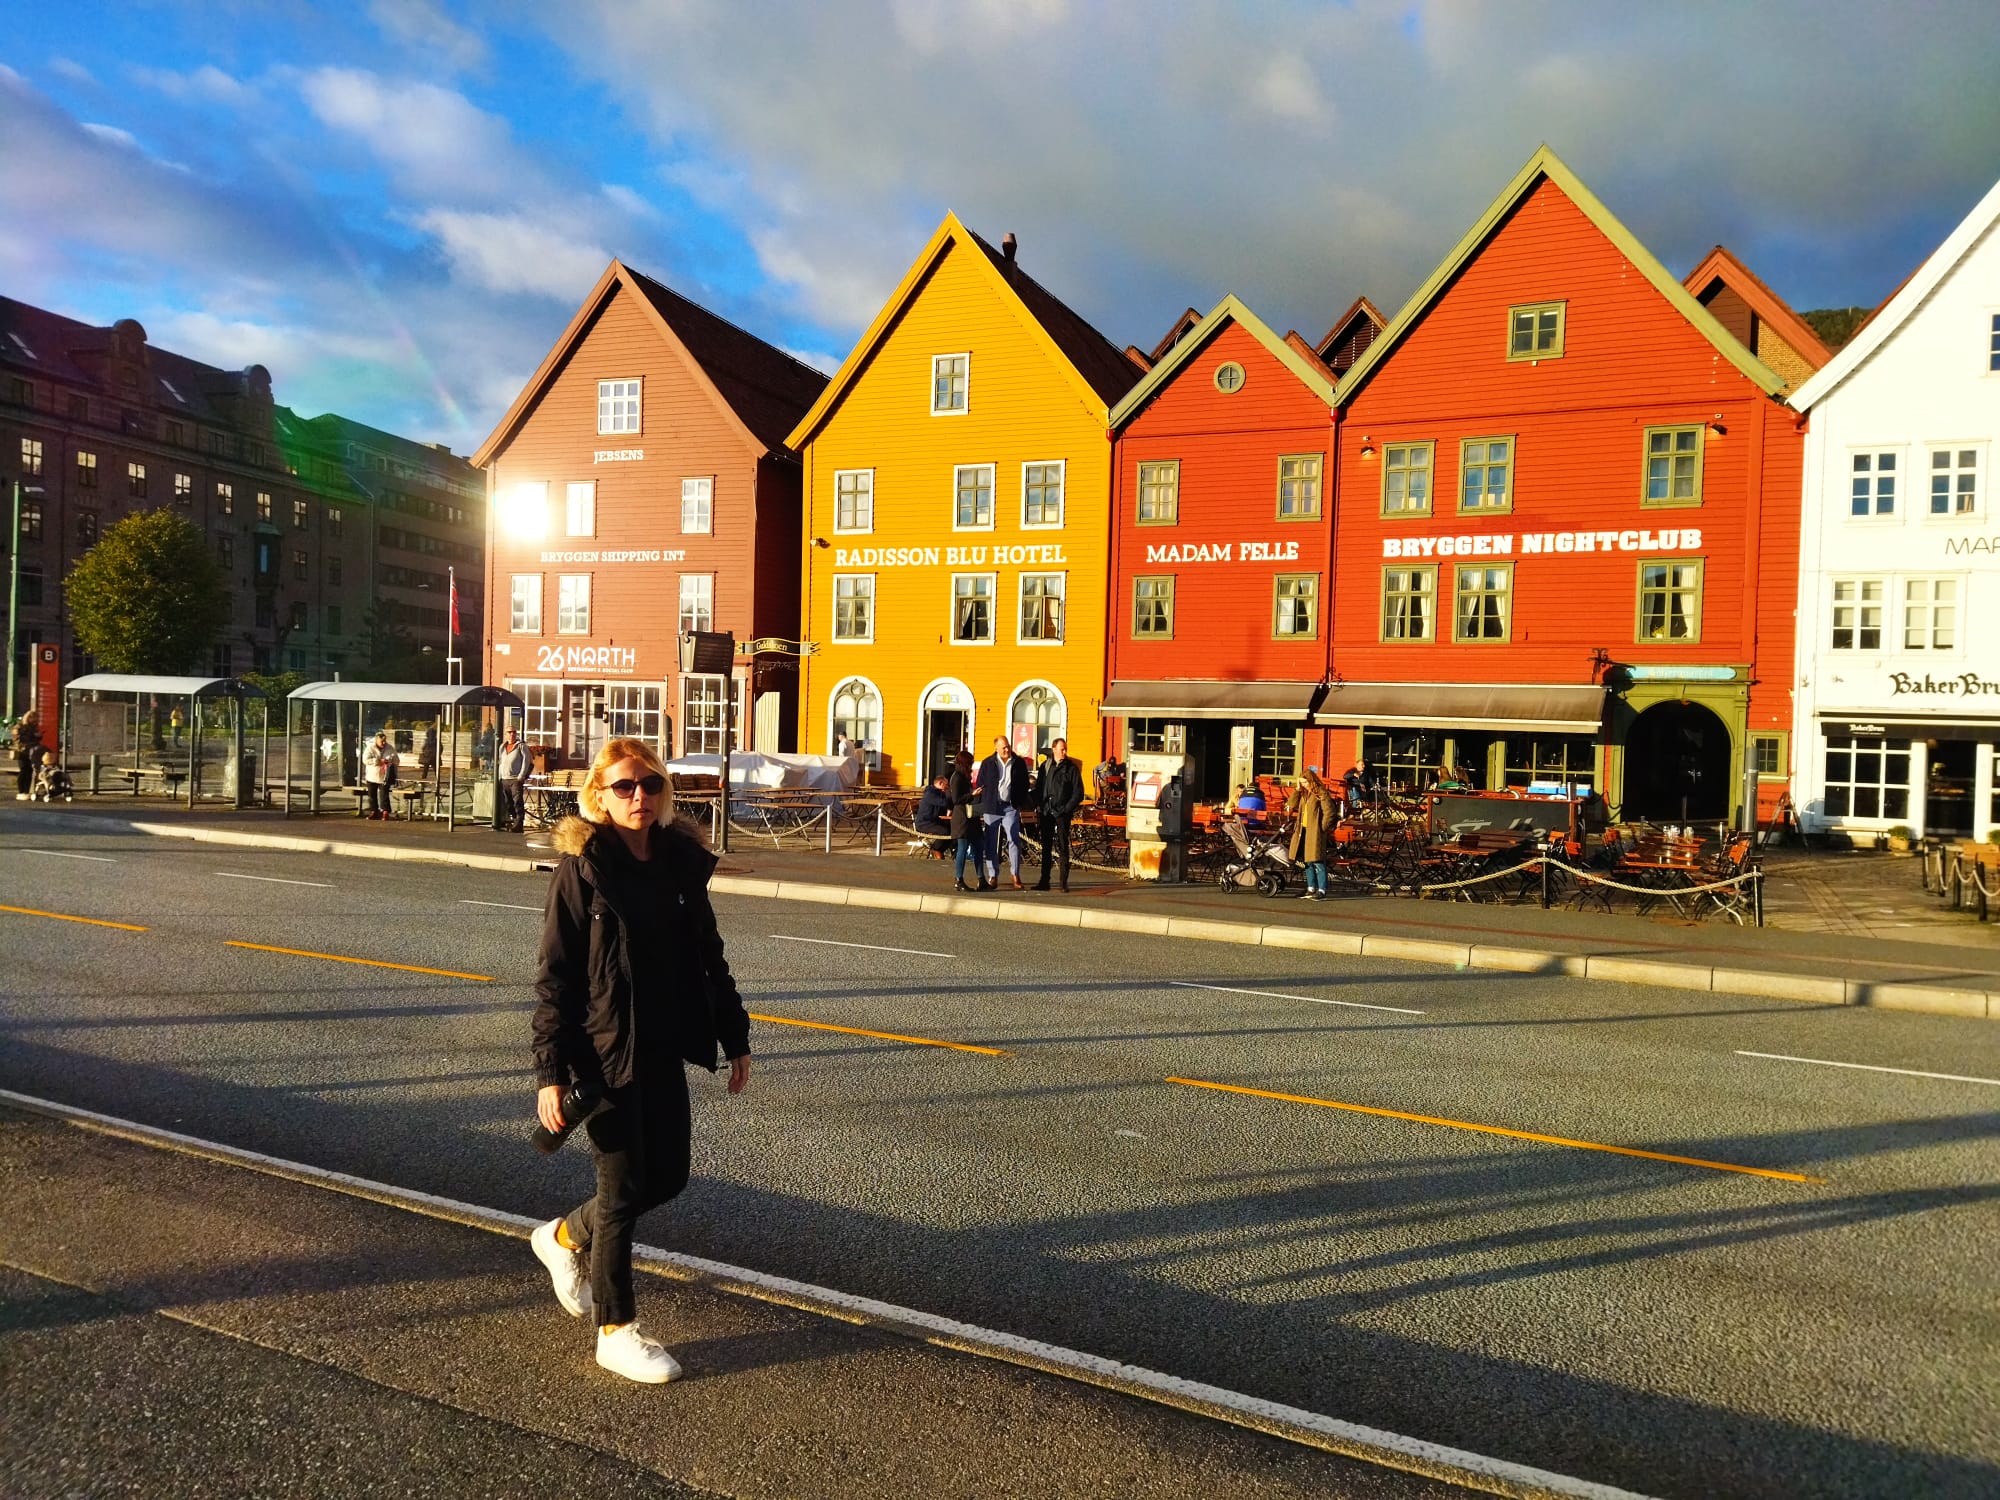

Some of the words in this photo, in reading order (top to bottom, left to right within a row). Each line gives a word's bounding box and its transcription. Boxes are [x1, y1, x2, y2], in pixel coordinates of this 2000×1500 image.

[593, 449, 644, 464] JEBSENS
[1146, 543, 1232, 562] MADAM
[1239, 541, 1299, 561] FELLE
[1383, 535, 1513, 557] BRYGGEN
[1522, 529, 1702, 553] NIGHTCLUB
[540, 551, 599, 563] BRYGGEN
[601, 550, 660, 562] SHIPPING
[663, 550, 686, 561] INT
[835, 548, 940, 567] RADISSON
[946, 546, 987, 565] BLU
[992, 545, 1067, 564] HOTEL
[45, 650, 54, 660] B
[536, 645, 565, 672] 26
[567, 646, 635, 667] NORTH
